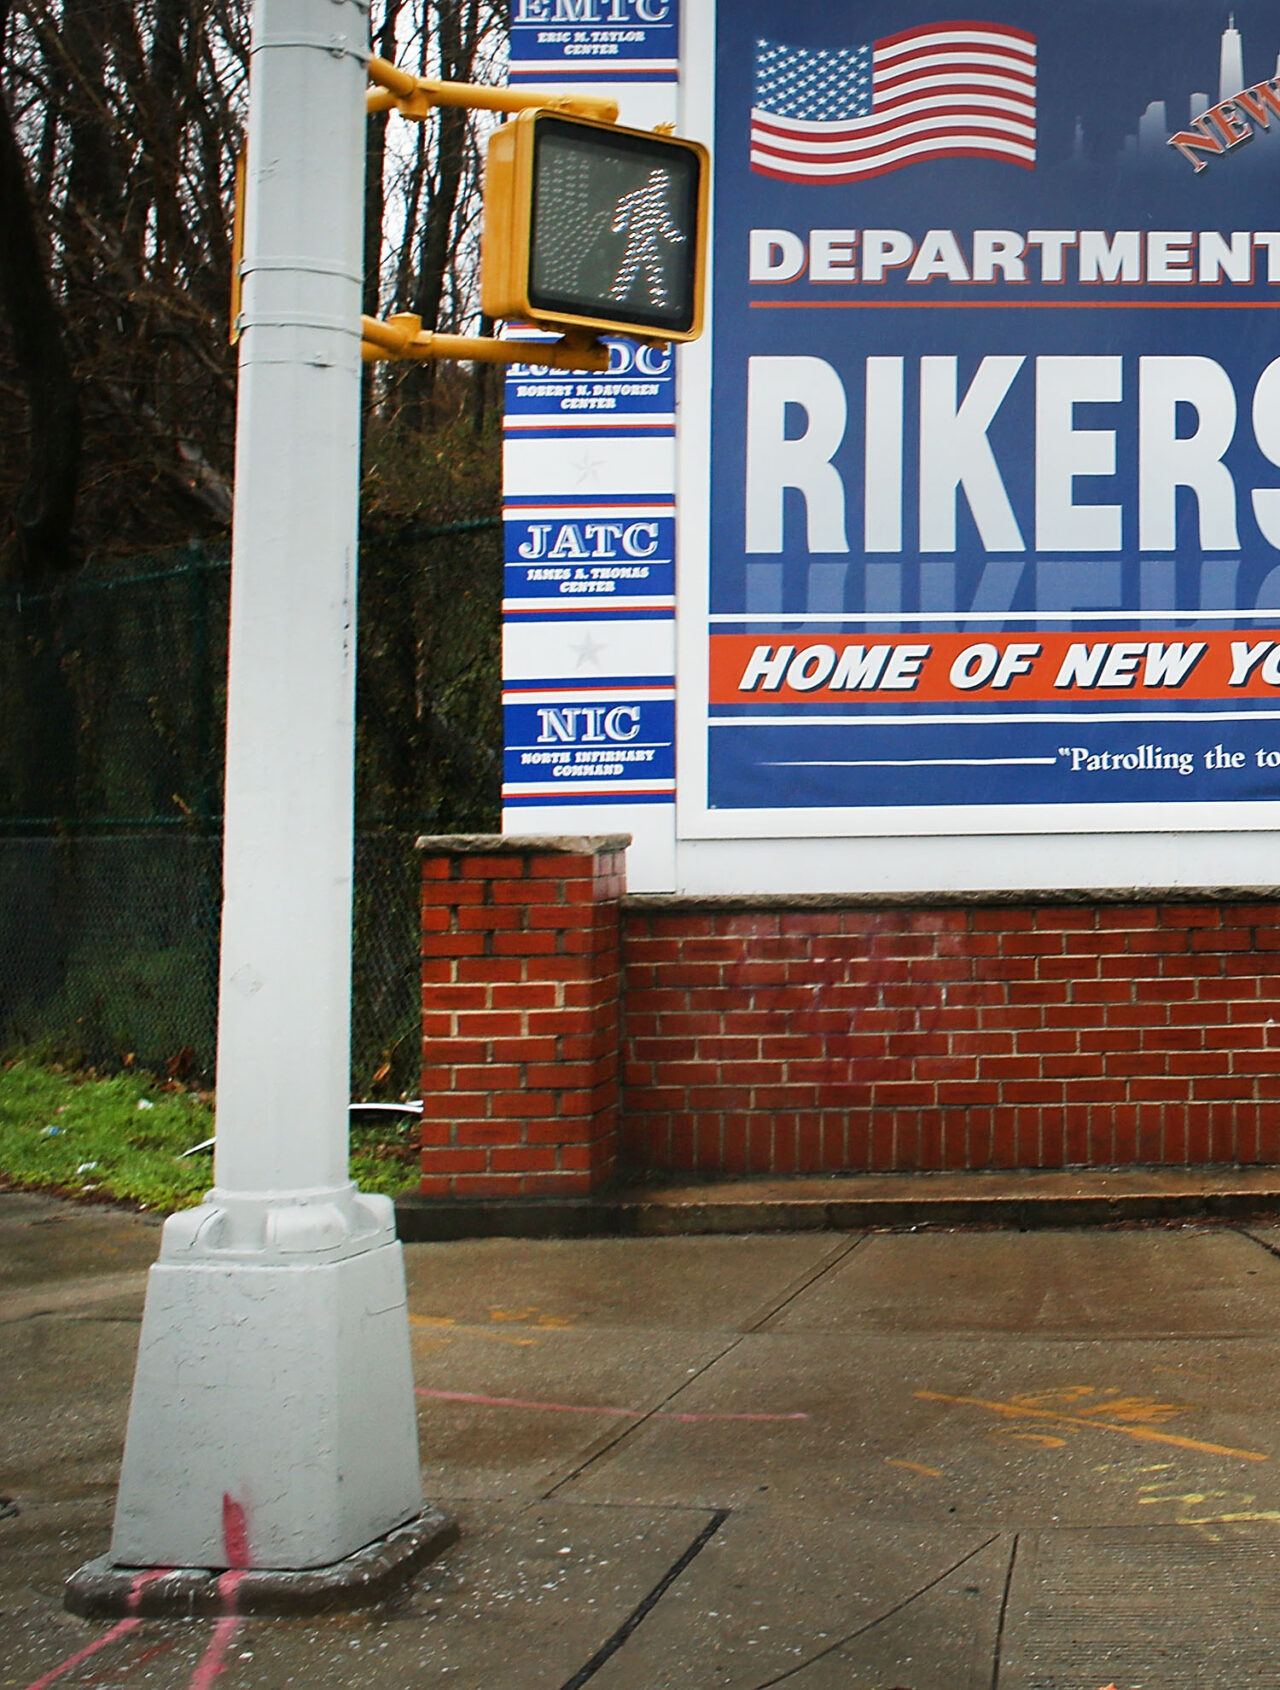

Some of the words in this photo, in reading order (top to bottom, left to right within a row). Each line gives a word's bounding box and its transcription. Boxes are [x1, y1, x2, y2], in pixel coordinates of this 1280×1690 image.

[564, 44, 618, 55] CENTER
[506, 342, 672, 376] DC
[560, 398, 617, 409] CENTER
[518, 522, 660, 559] JATC
[560, 581, 616, 593] CENTER
[738, 643, 930, 694] HOME
[949, 643, 1045, 692] OF
[1053, 642, 1208, 691] NEW
[536, 706, 640, 742] NIC
[521, 752, 571, 764] NORTH
[1058, 745, 1194, 775] "Patrolling
[1204, 744, 1246, 769] the
[553, 764, 624, 777] COMMAND
